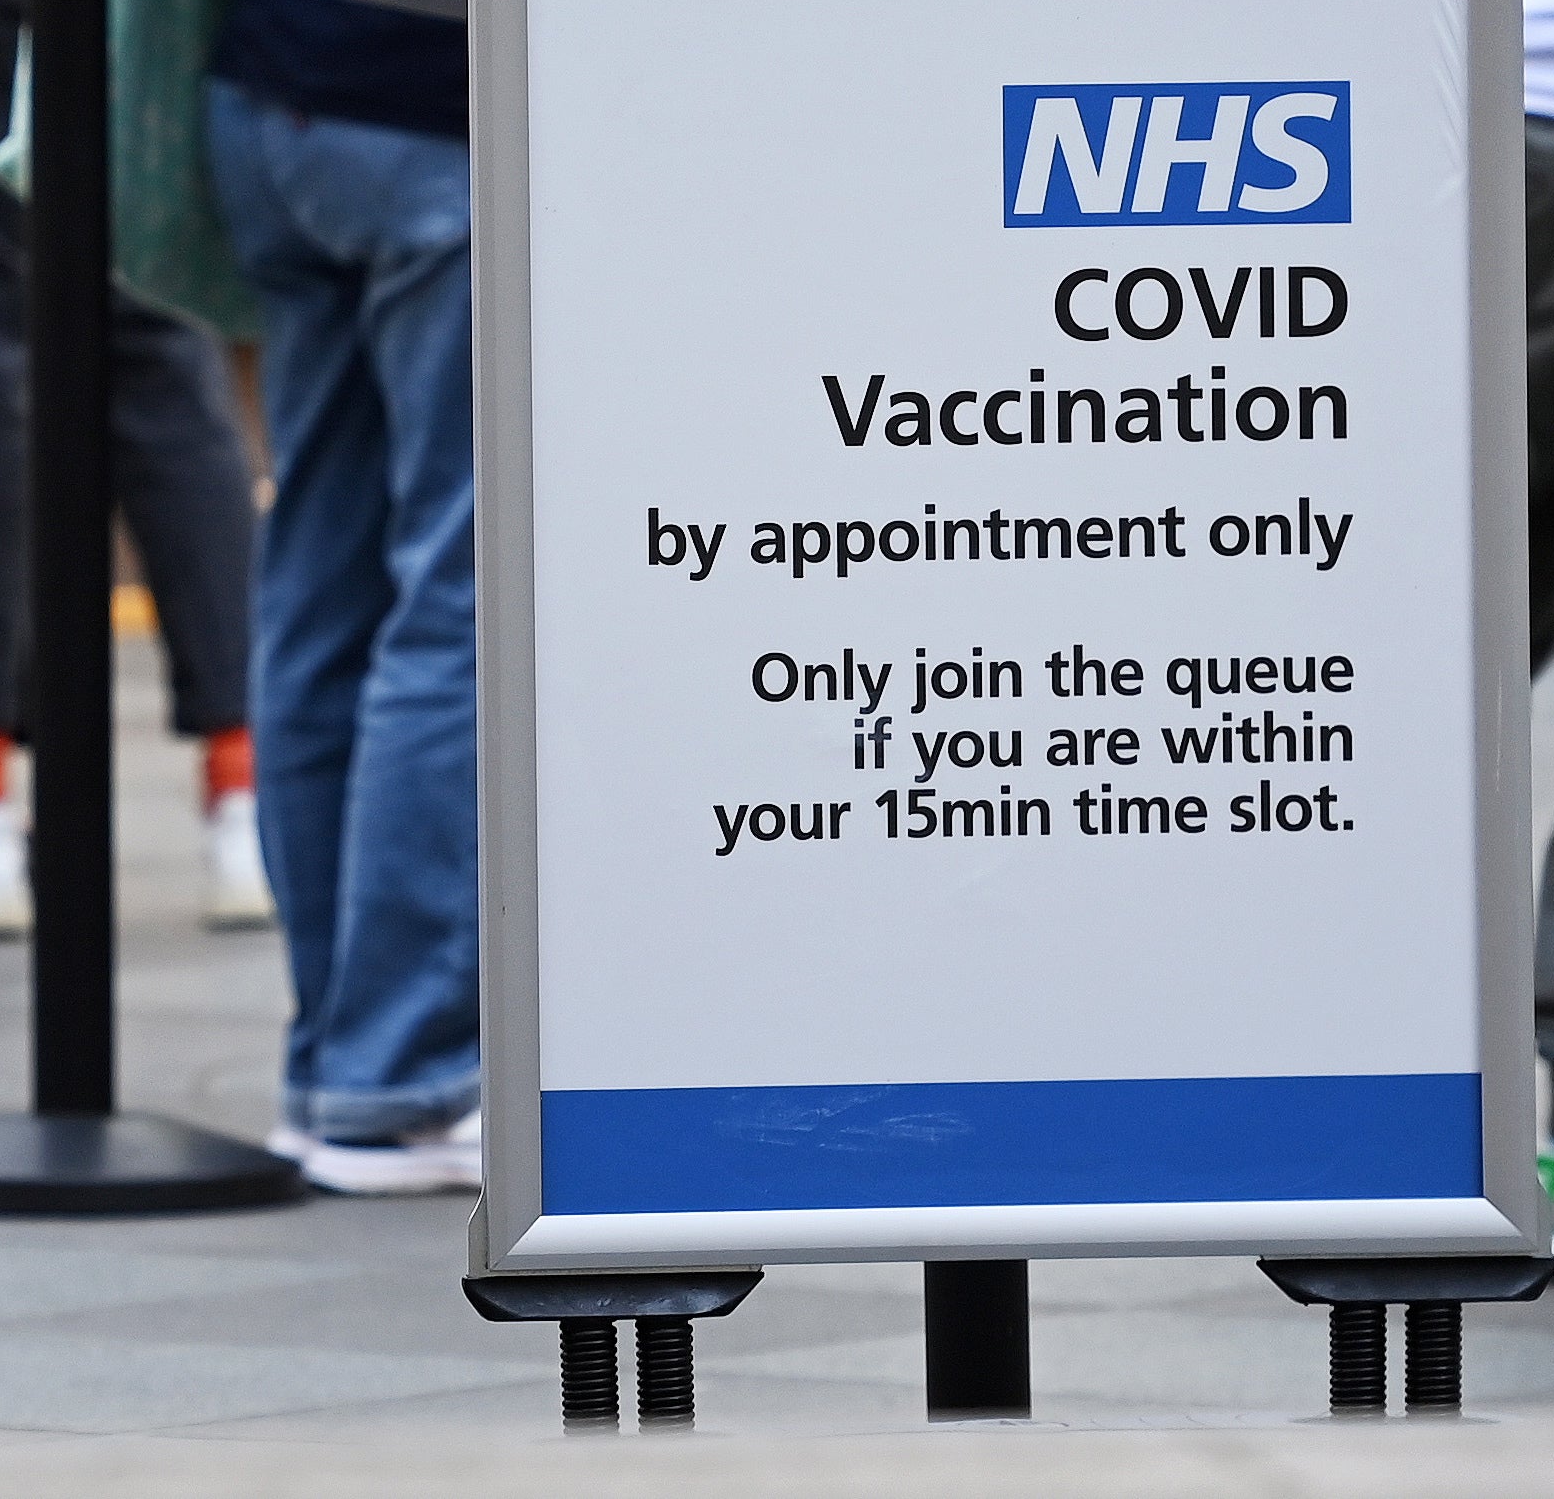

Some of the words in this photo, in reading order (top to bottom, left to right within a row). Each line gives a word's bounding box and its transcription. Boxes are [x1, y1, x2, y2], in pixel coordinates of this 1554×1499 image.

[1013, 92, 1338, 215] NHS
[1055, 267, 1348, 341] COVID
[821, 366, 1347, 446] Vaccination
[648, 508, 727, 581] by
[751, 504, 1186, 578] appointment
[1210, 497, 1353, 571] only
[752, 648, 892, 714] Only
[911, 647, 1022, 714] join
[1045, 644, 1143, 697] the
[1167, 656, 1354, 708] queue
[855, 717, 892, 769] if
[912, 731, 1022, 783] you
[1047, 728, 1140, 766] are
[1161, 710, 1352, 763] within
[713, 802, 851, 856] your
[876, 785, 1050, 838] 15min
[1073, 783, 1207, 835] time
[1230, 780, 1353, 832] slot.
